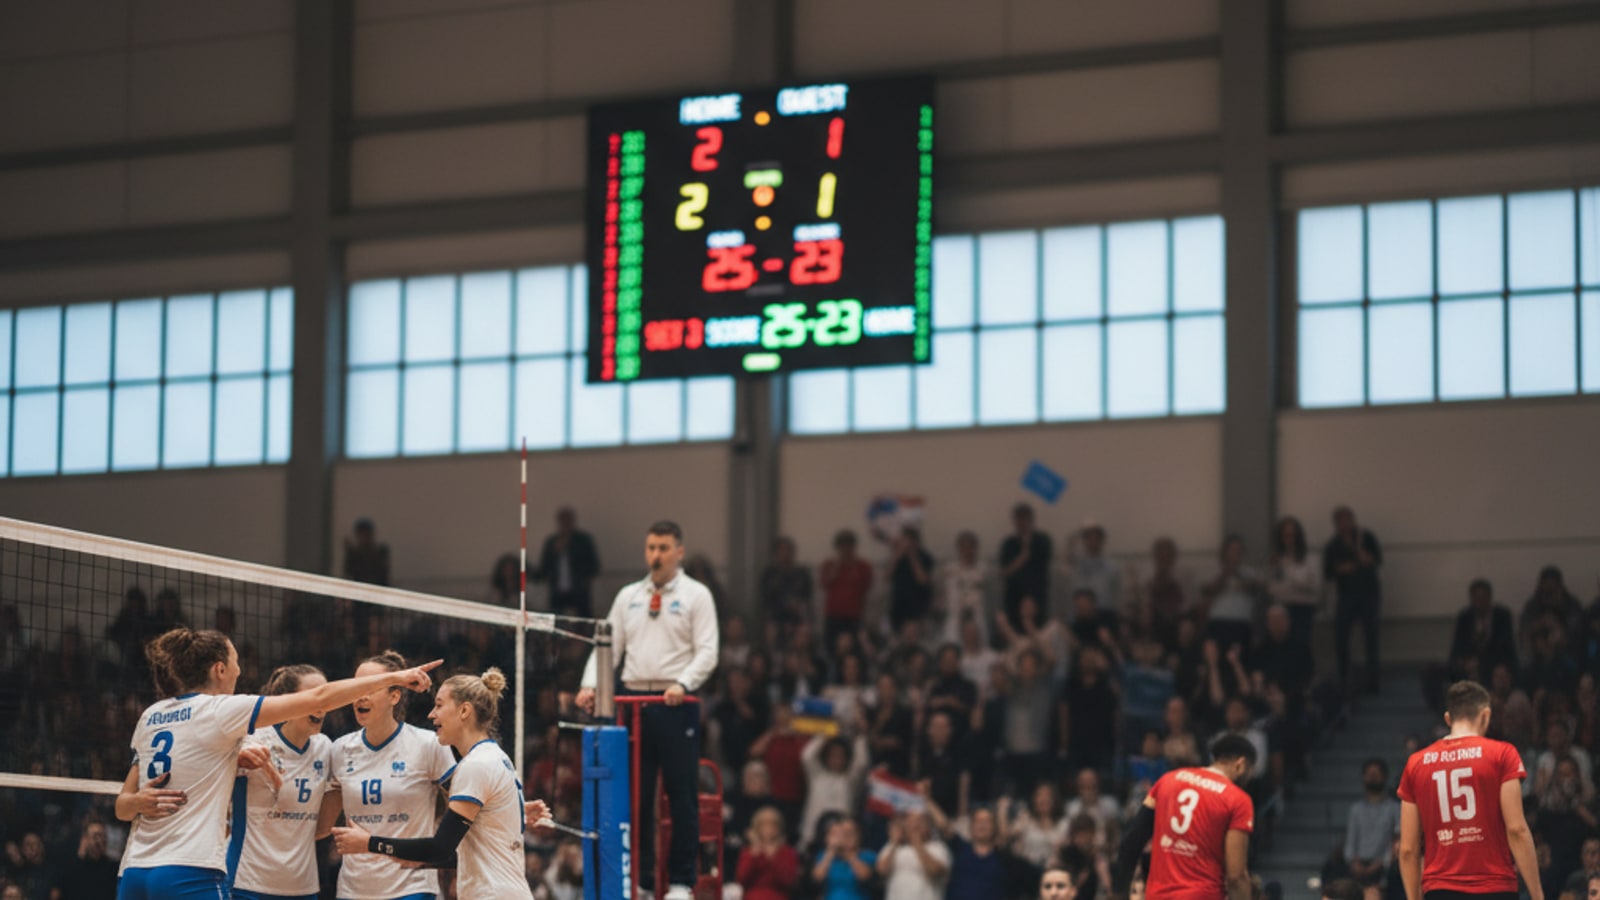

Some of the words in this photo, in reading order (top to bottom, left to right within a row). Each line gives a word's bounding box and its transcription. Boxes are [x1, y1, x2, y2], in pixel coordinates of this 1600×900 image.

[691, 126, 723, 172] 2
[826, 117, 845, 159] 1
[675, 182, 709, 231] 2
[816, 172, 837, 218] 1
[702, 243, 758, 293] 25
[789, 237, 844, 285] 23
[361, 778, 383, 805] 19
[1170, 788, 1200, 835] 3
[1431, 767, 1477, 823] 15
